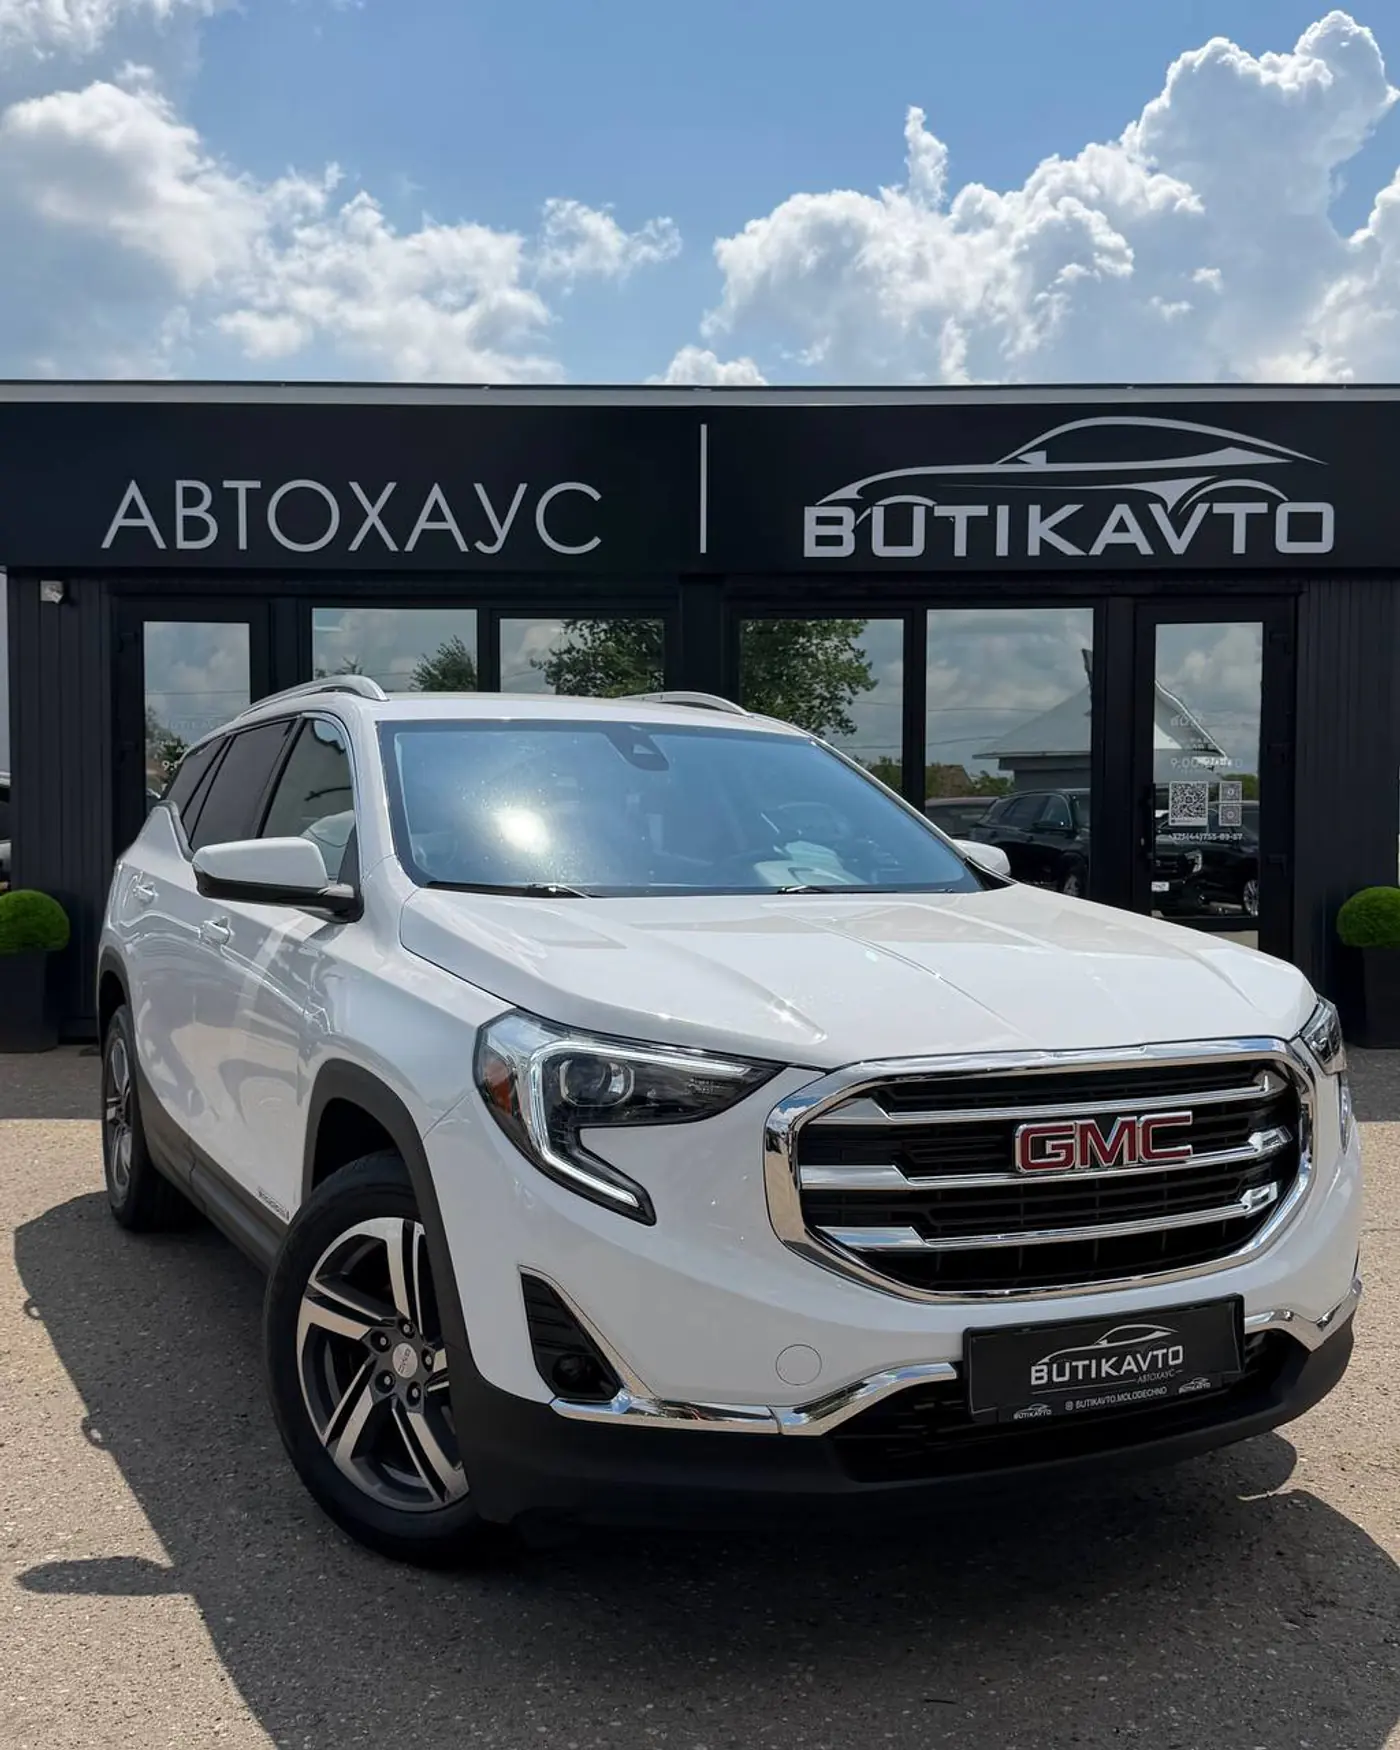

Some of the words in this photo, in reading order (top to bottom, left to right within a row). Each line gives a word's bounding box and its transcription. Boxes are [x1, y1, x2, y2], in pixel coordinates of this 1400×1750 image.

[102, 479, 603, 555] АВТОХАУС
[803, 501, 1335, 558] BUTIKAVTO
[1015, 1111, 1193, 1173] GMC
[1030, 1345, 1184, 1386] BUTIKAVTO
